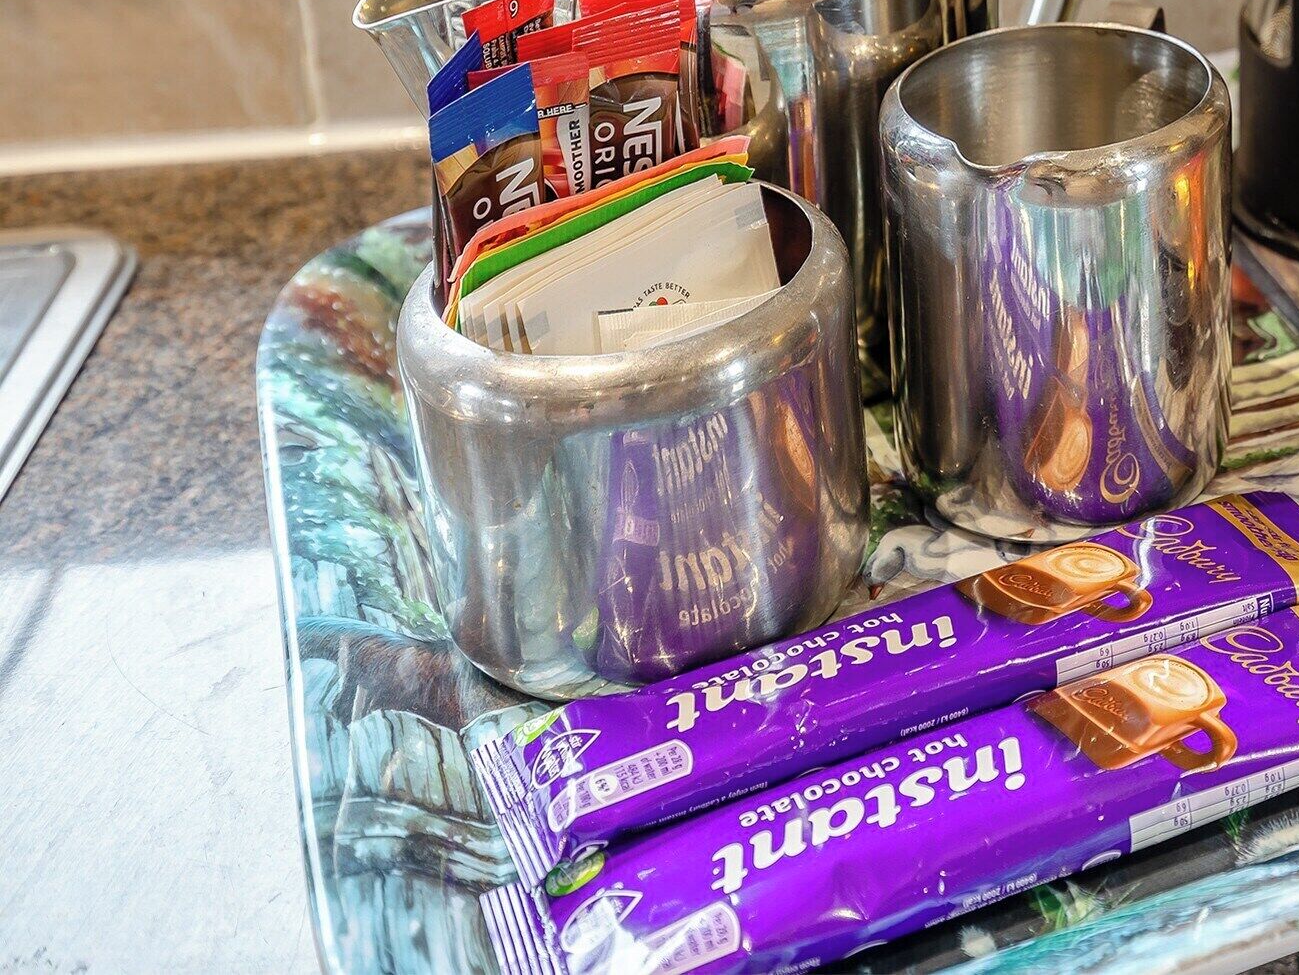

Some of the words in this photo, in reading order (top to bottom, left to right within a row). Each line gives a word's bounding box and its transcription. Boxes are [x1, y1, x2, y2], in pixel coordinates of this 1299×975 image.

[547, 105, 573, 116] HERE
[623, 97, 662, 176] NES
[569, 119, 585, 194] MOOTHER
[643, 282, 662, 297] TASTE
[665, 282, 690, 298] BETTER
[1116, 514, 1241, 584] Cadbury
[847, 612, 903, 634] hot
[1242, 602, 1255, 613] Salt
[665, 615, 958, 733] instant
[692, 631, 840, 689] chocolate
[907, 733, 968, 763] hot
[918, 719, 935, 731] 2000
[710, 737, 1026, 894] instant
[738, 756, 901, 827] chocolate
